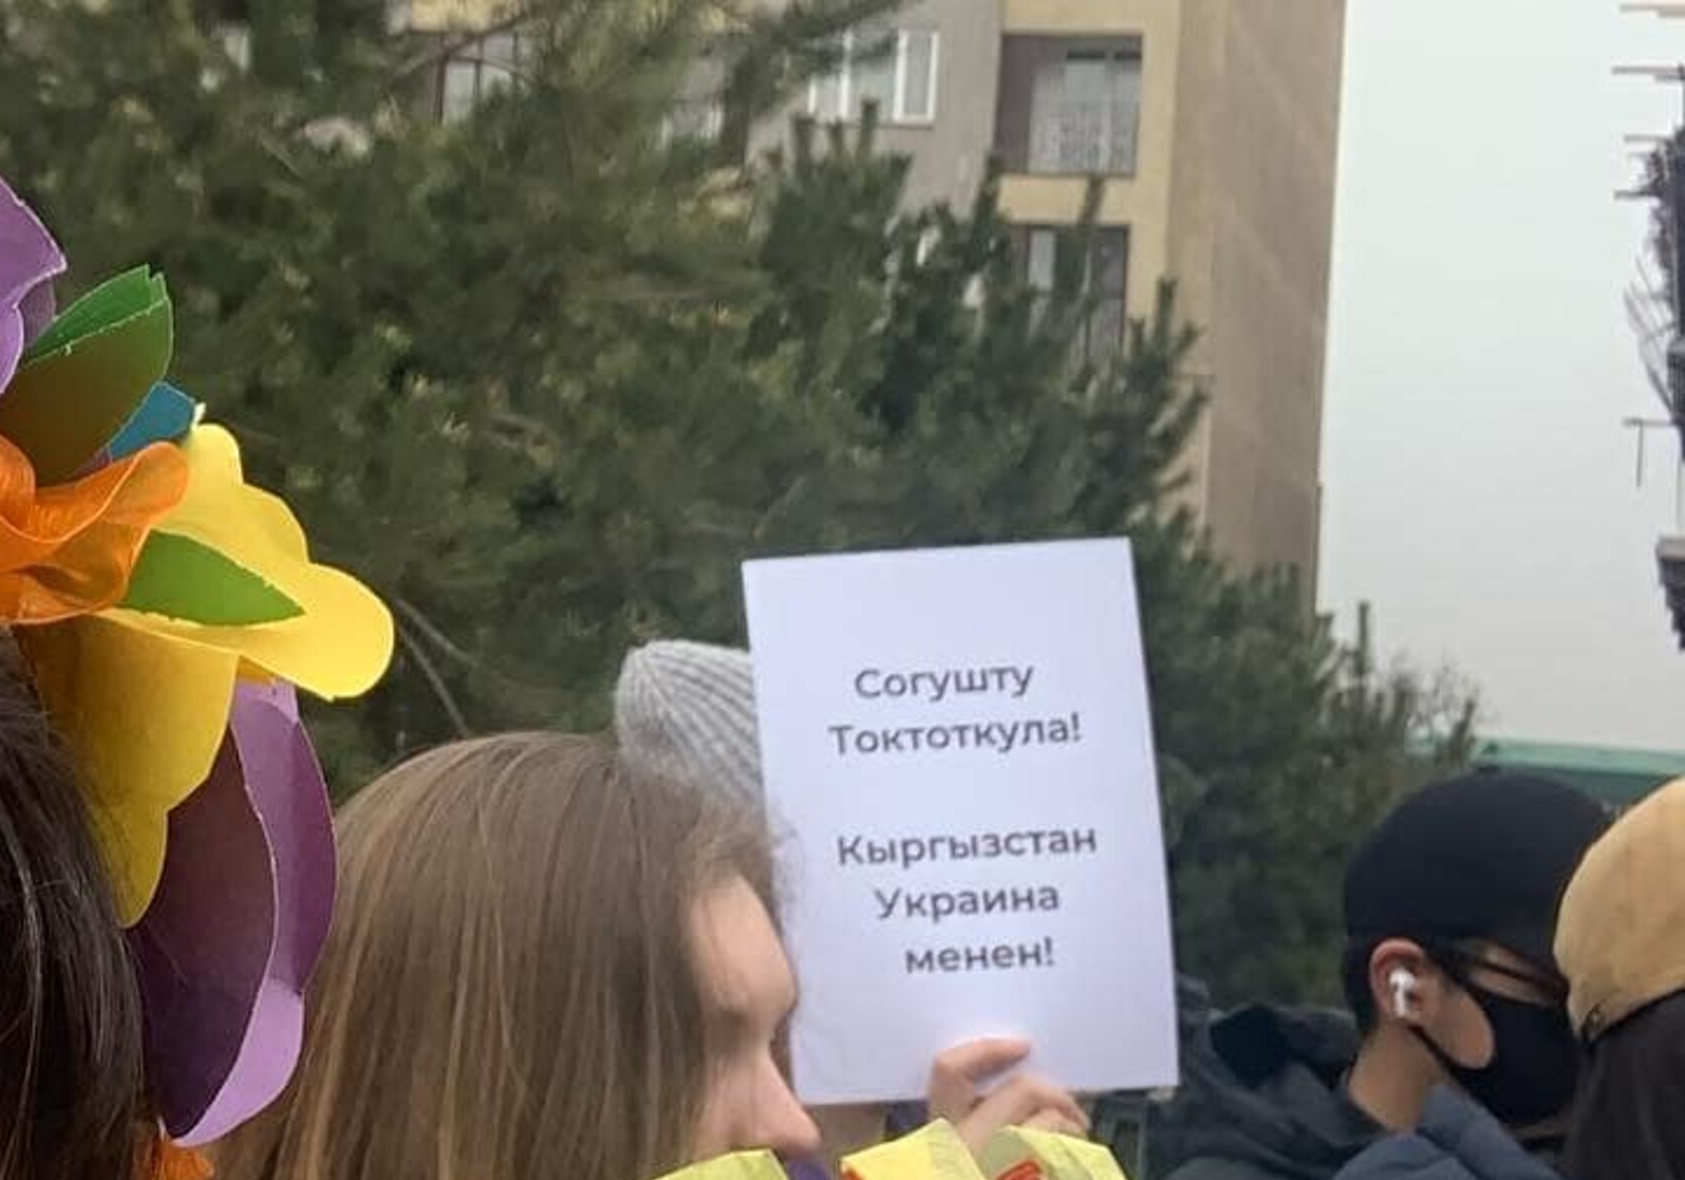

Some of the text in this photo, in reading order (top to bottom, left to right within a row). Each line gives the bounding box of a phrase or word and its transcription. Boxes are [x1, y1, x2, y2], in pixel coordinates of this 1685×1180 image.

[853, 664, 1035, 703] Согушту
[827, 711, 1083, 756] Токтоткула!
[837, 828, 1098, 870] Кыргызстан
[874, 884, 1061, 924] Украина
[904, 935, 1056, 975] менен!
